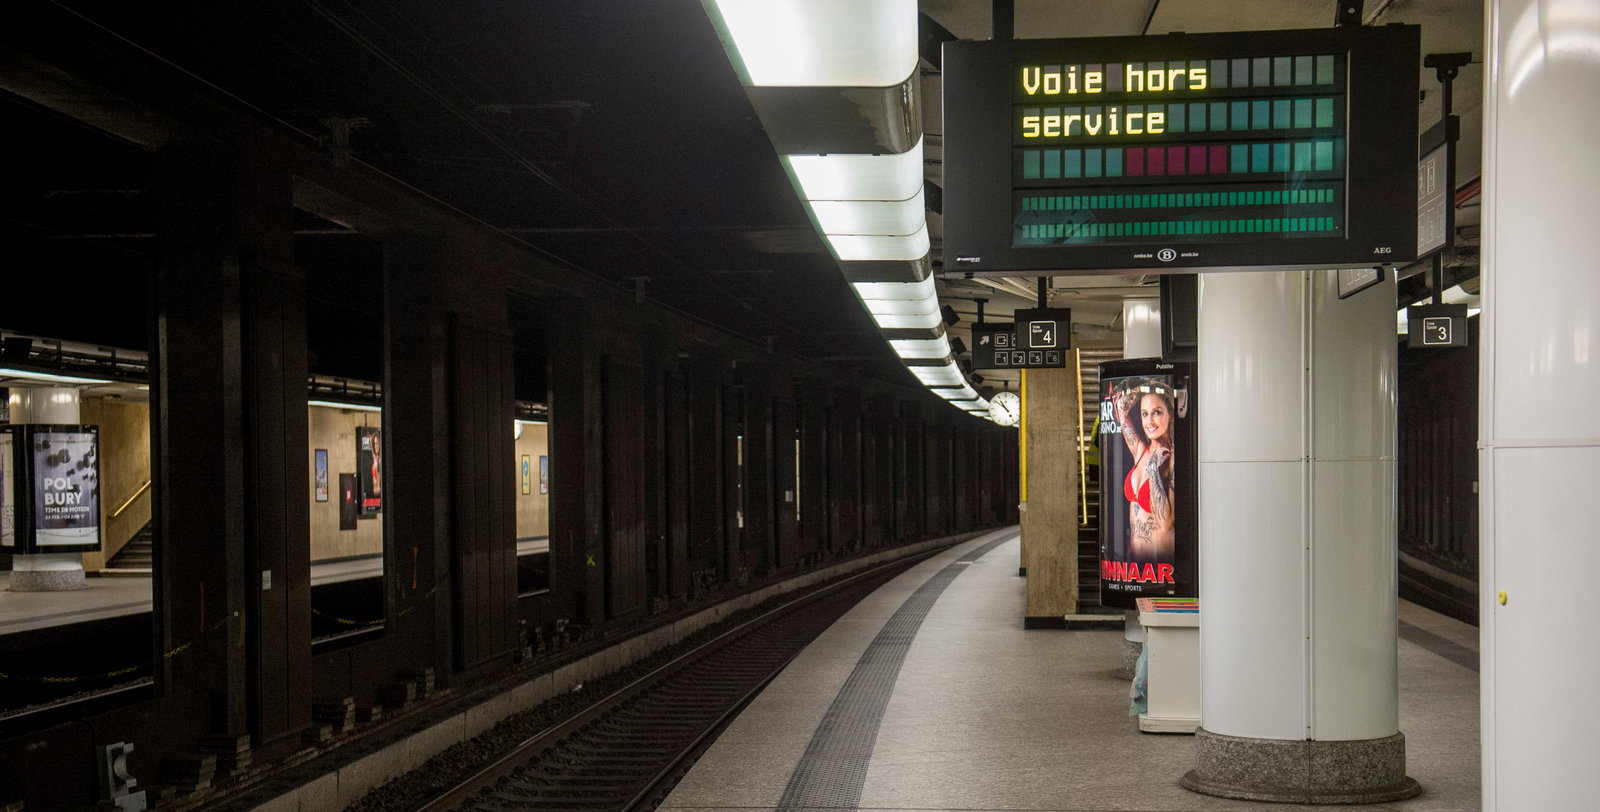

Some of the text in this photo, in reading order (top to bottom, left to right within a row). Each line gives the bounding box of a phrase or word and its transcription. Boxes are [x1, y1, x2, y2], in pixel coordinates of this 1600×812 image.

[1022, 64, 1207, 95] Voie hors
[1022, 107, 1165, 138] service
[1373, 246, 1392, 254] AEG
[1043, 330, 1052, 343] 4
[1438, 326, 1447, 340] 3
[44, 477, 74, 490] POL
[44, 492, 82, 505] BURY
[69, 505, 90, 513] MOTION
[1124, 584, 1142, 592] SPORTS
